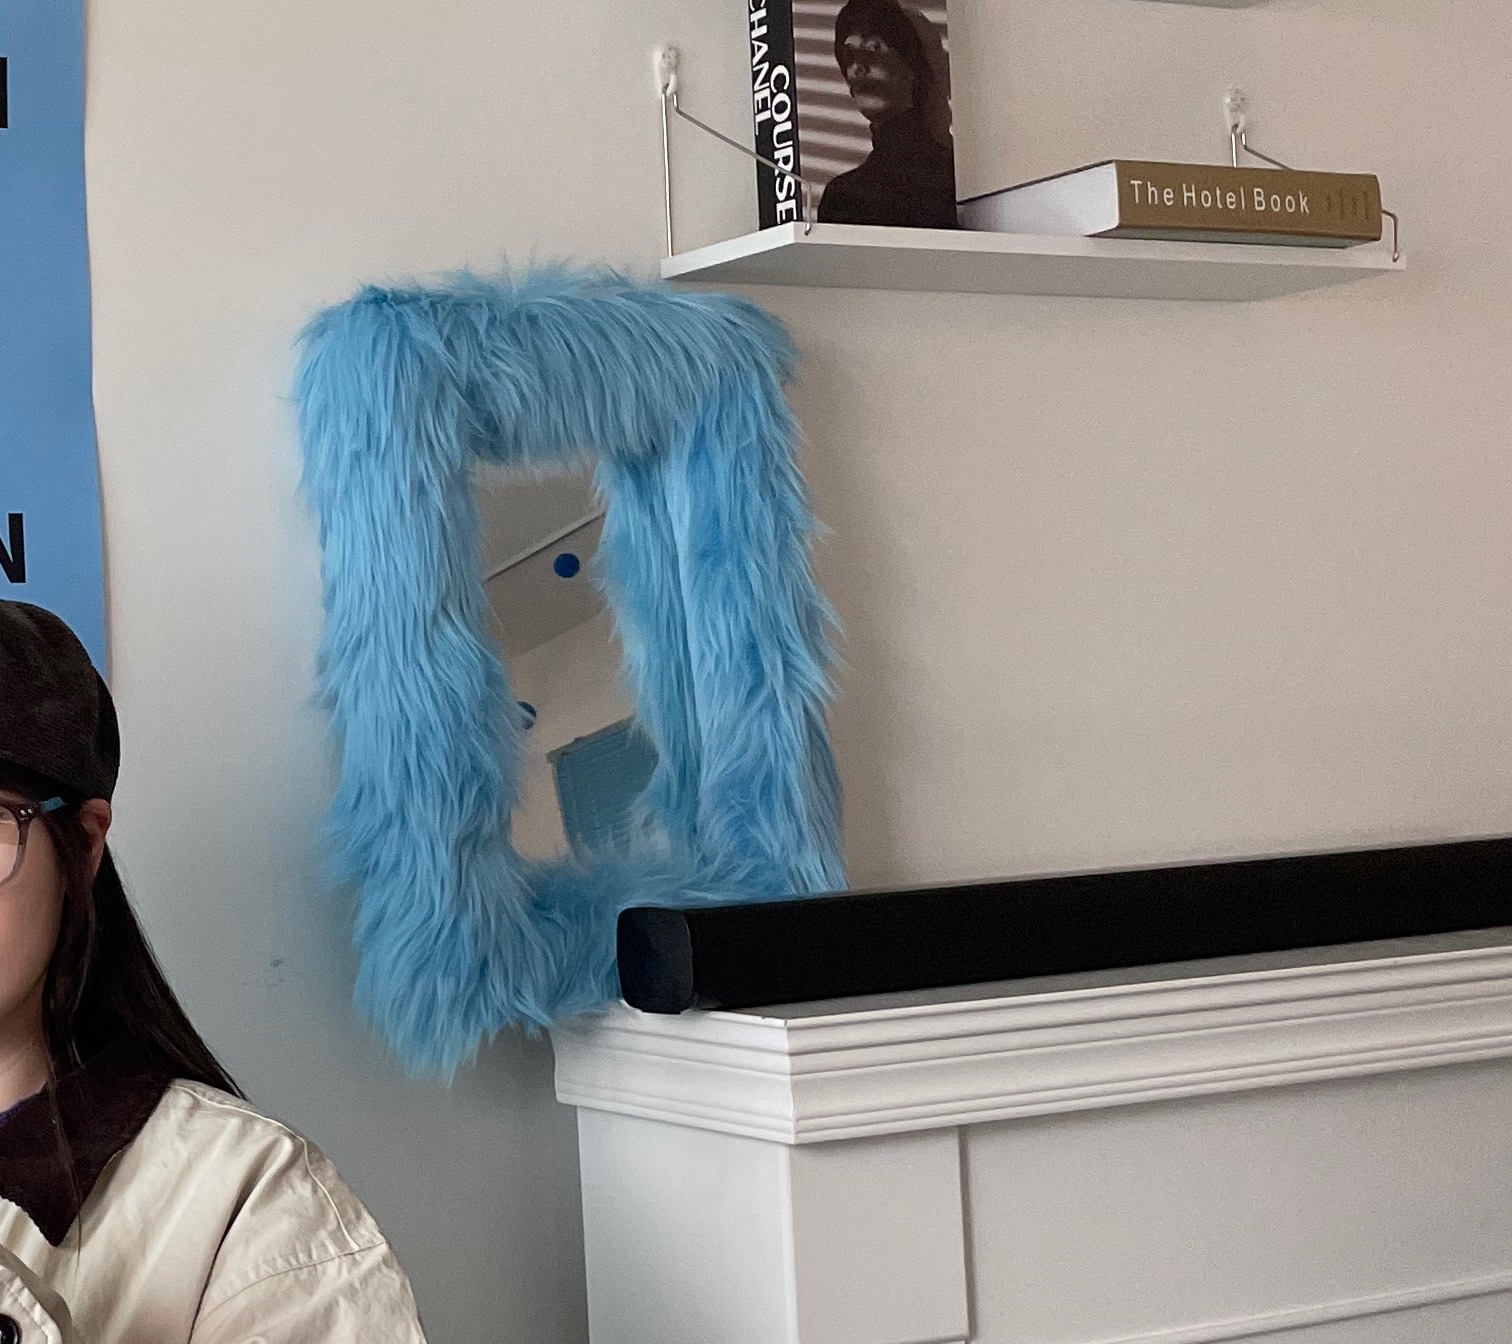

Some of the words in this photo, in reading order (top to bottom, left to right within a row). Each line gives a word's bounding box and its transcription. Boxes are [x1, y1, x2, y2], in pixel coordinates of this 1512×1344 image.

[770, 64, 798, 225] COURSE
[1130, 180, 1174, 206] The
[1182, 183, 1246, 211] Hotel
[1253, 187, 1310, 214] Book
